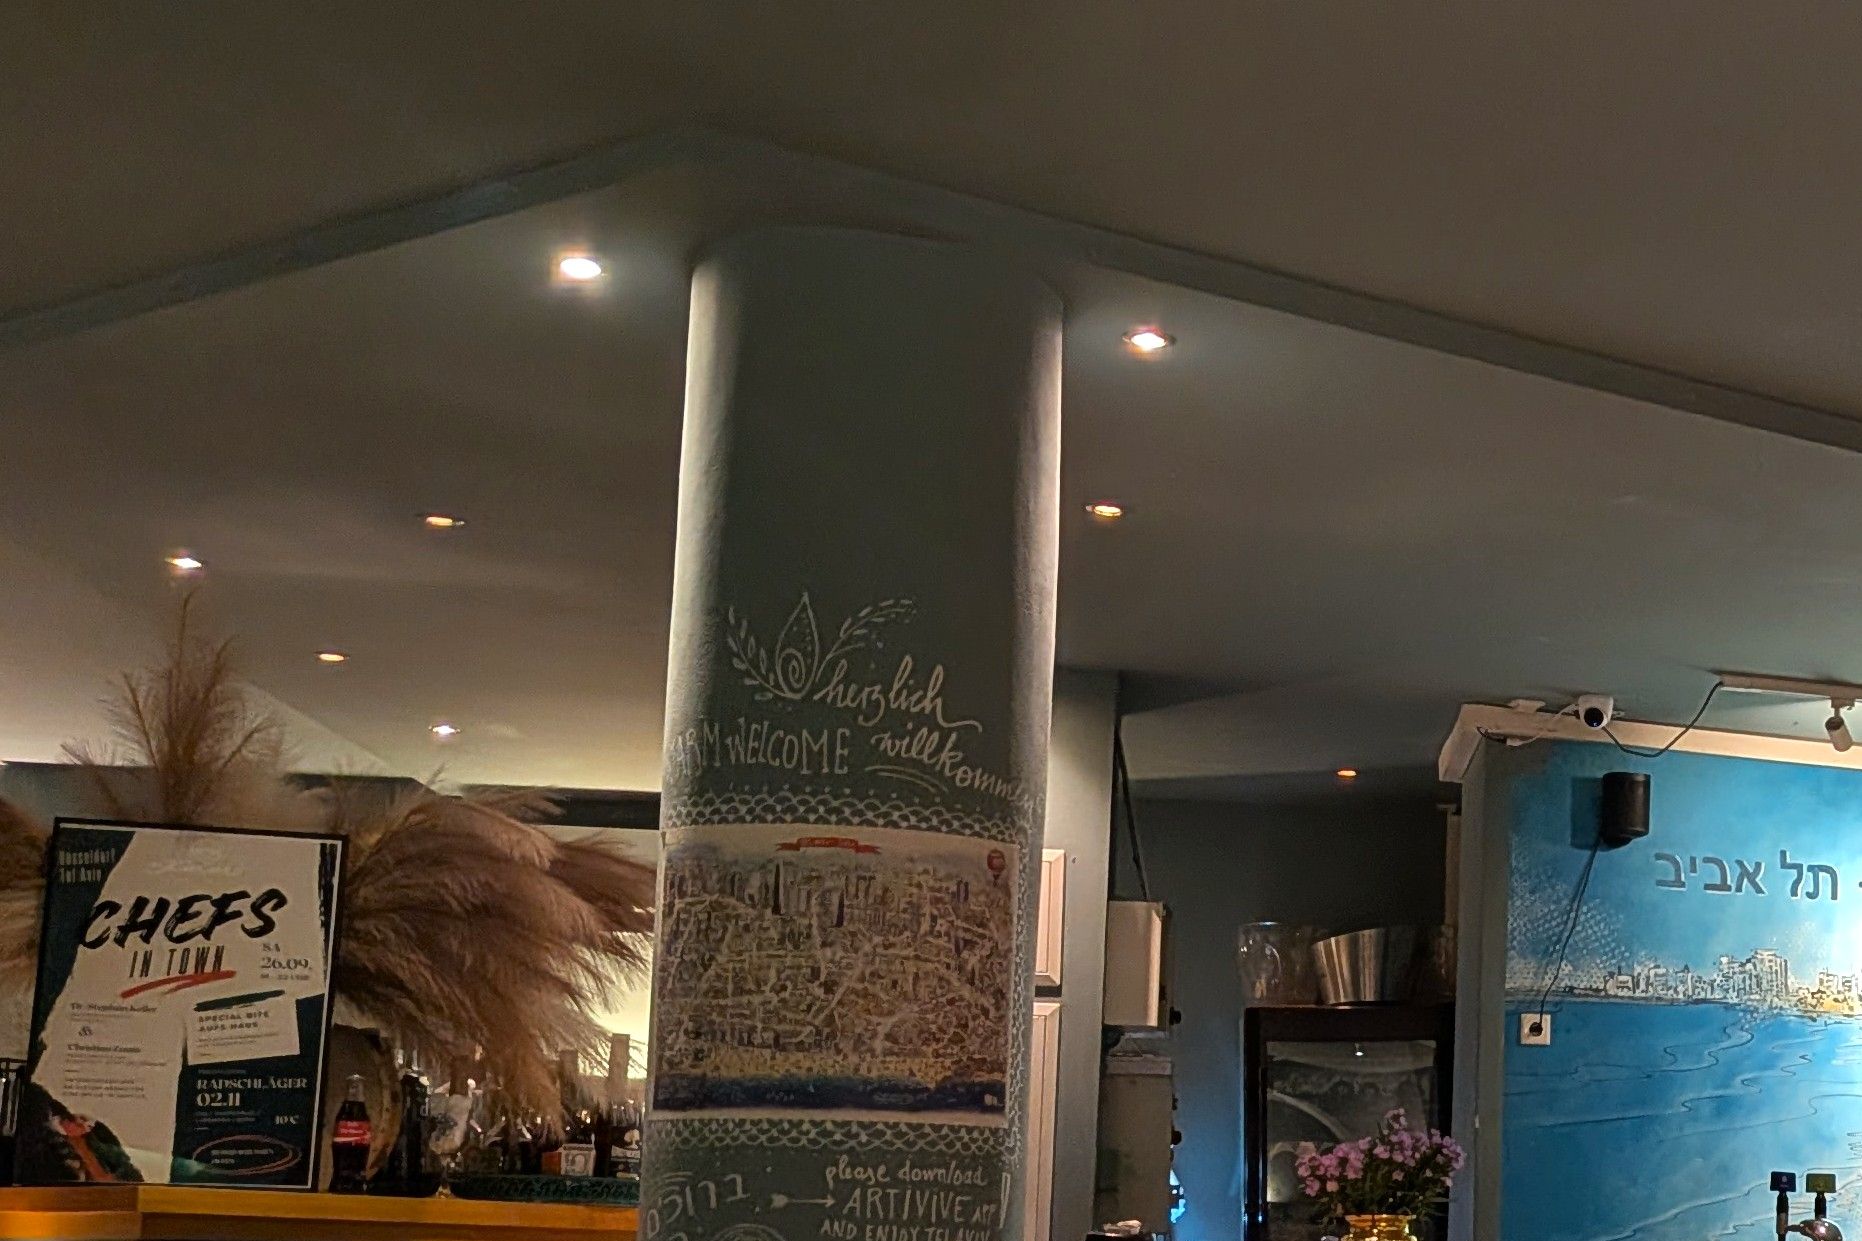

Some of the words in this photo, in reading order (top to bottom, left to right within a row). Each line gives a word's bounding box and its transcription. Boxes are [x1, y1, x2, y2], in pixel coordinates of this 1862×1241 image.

[813, 655, 982, 732] herzlich
[725, 715, 850, 774] WELCOME
[1654, 851, 1767, 895] אביב
[1779, 849, 1838, 900] תל
[81, 888, 288, 949] CHEFS
[129, 950, 152, 977] IN
[166, 945, 225, 976] TOWN
[199, 1013, 241, 1022] SPECIAL
[197, 1076, 307, 1090] RADSCHLÄGER
[825, 1154, 891, 1190] please
[898, 1158, 988, 1186] download
[842, 1186, 971, 1224] ARTIVIVE
[820, 1219, 857, 1241] AND
